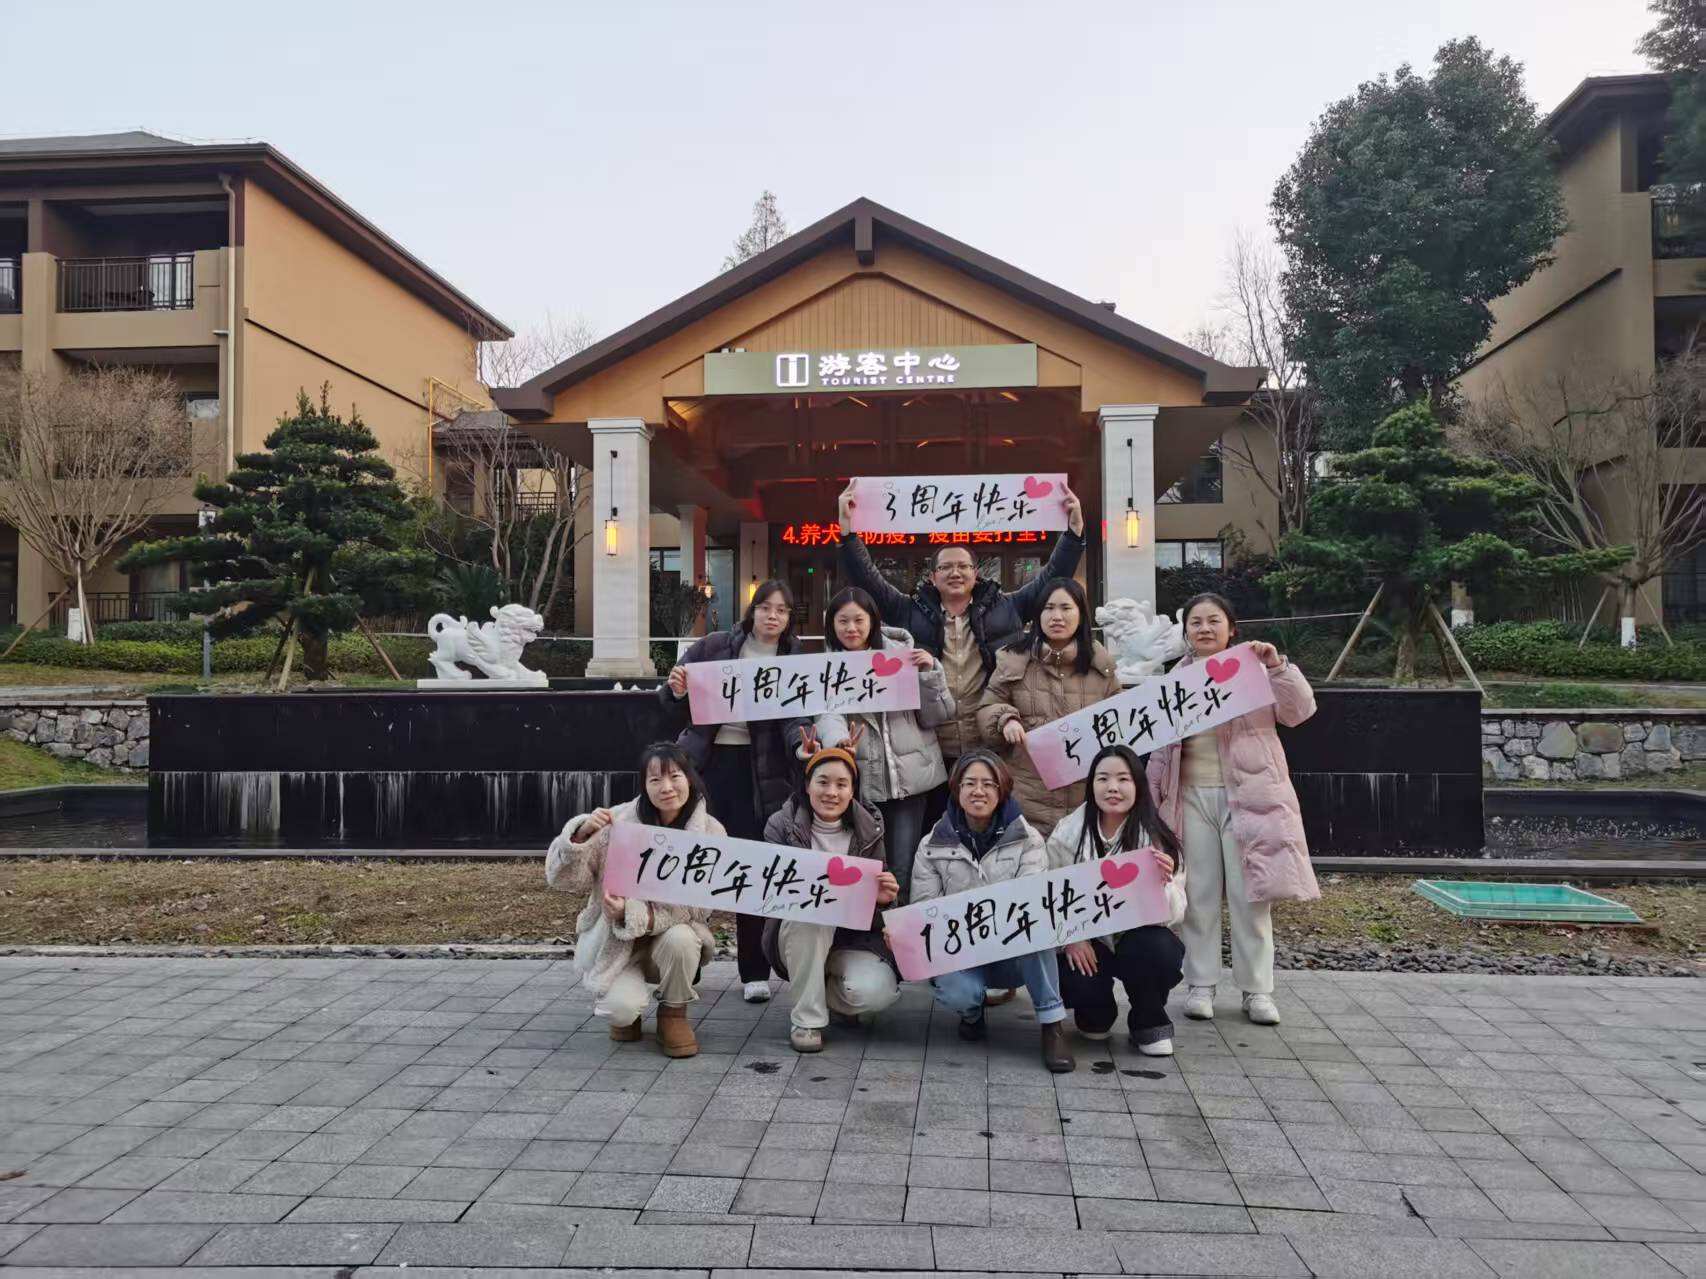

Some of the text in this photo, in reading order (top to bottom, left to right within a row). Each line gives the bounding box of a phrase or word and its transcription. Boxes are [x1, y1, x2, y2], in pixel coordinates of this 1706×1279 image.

[818, 351, 960, 376] 游客中心
[822, 374, 955, 386] TOURIST CENTRE
[886, 482, 1036, 525] 3周年快乐
[722, 661, 887, 712] 4周年快乐
[1064, 677, 1232, 766] 5周年快乐
[637, 843, 838, 909] 10周年快乐
[920, 879, 1126, 962] 18周年快乐
